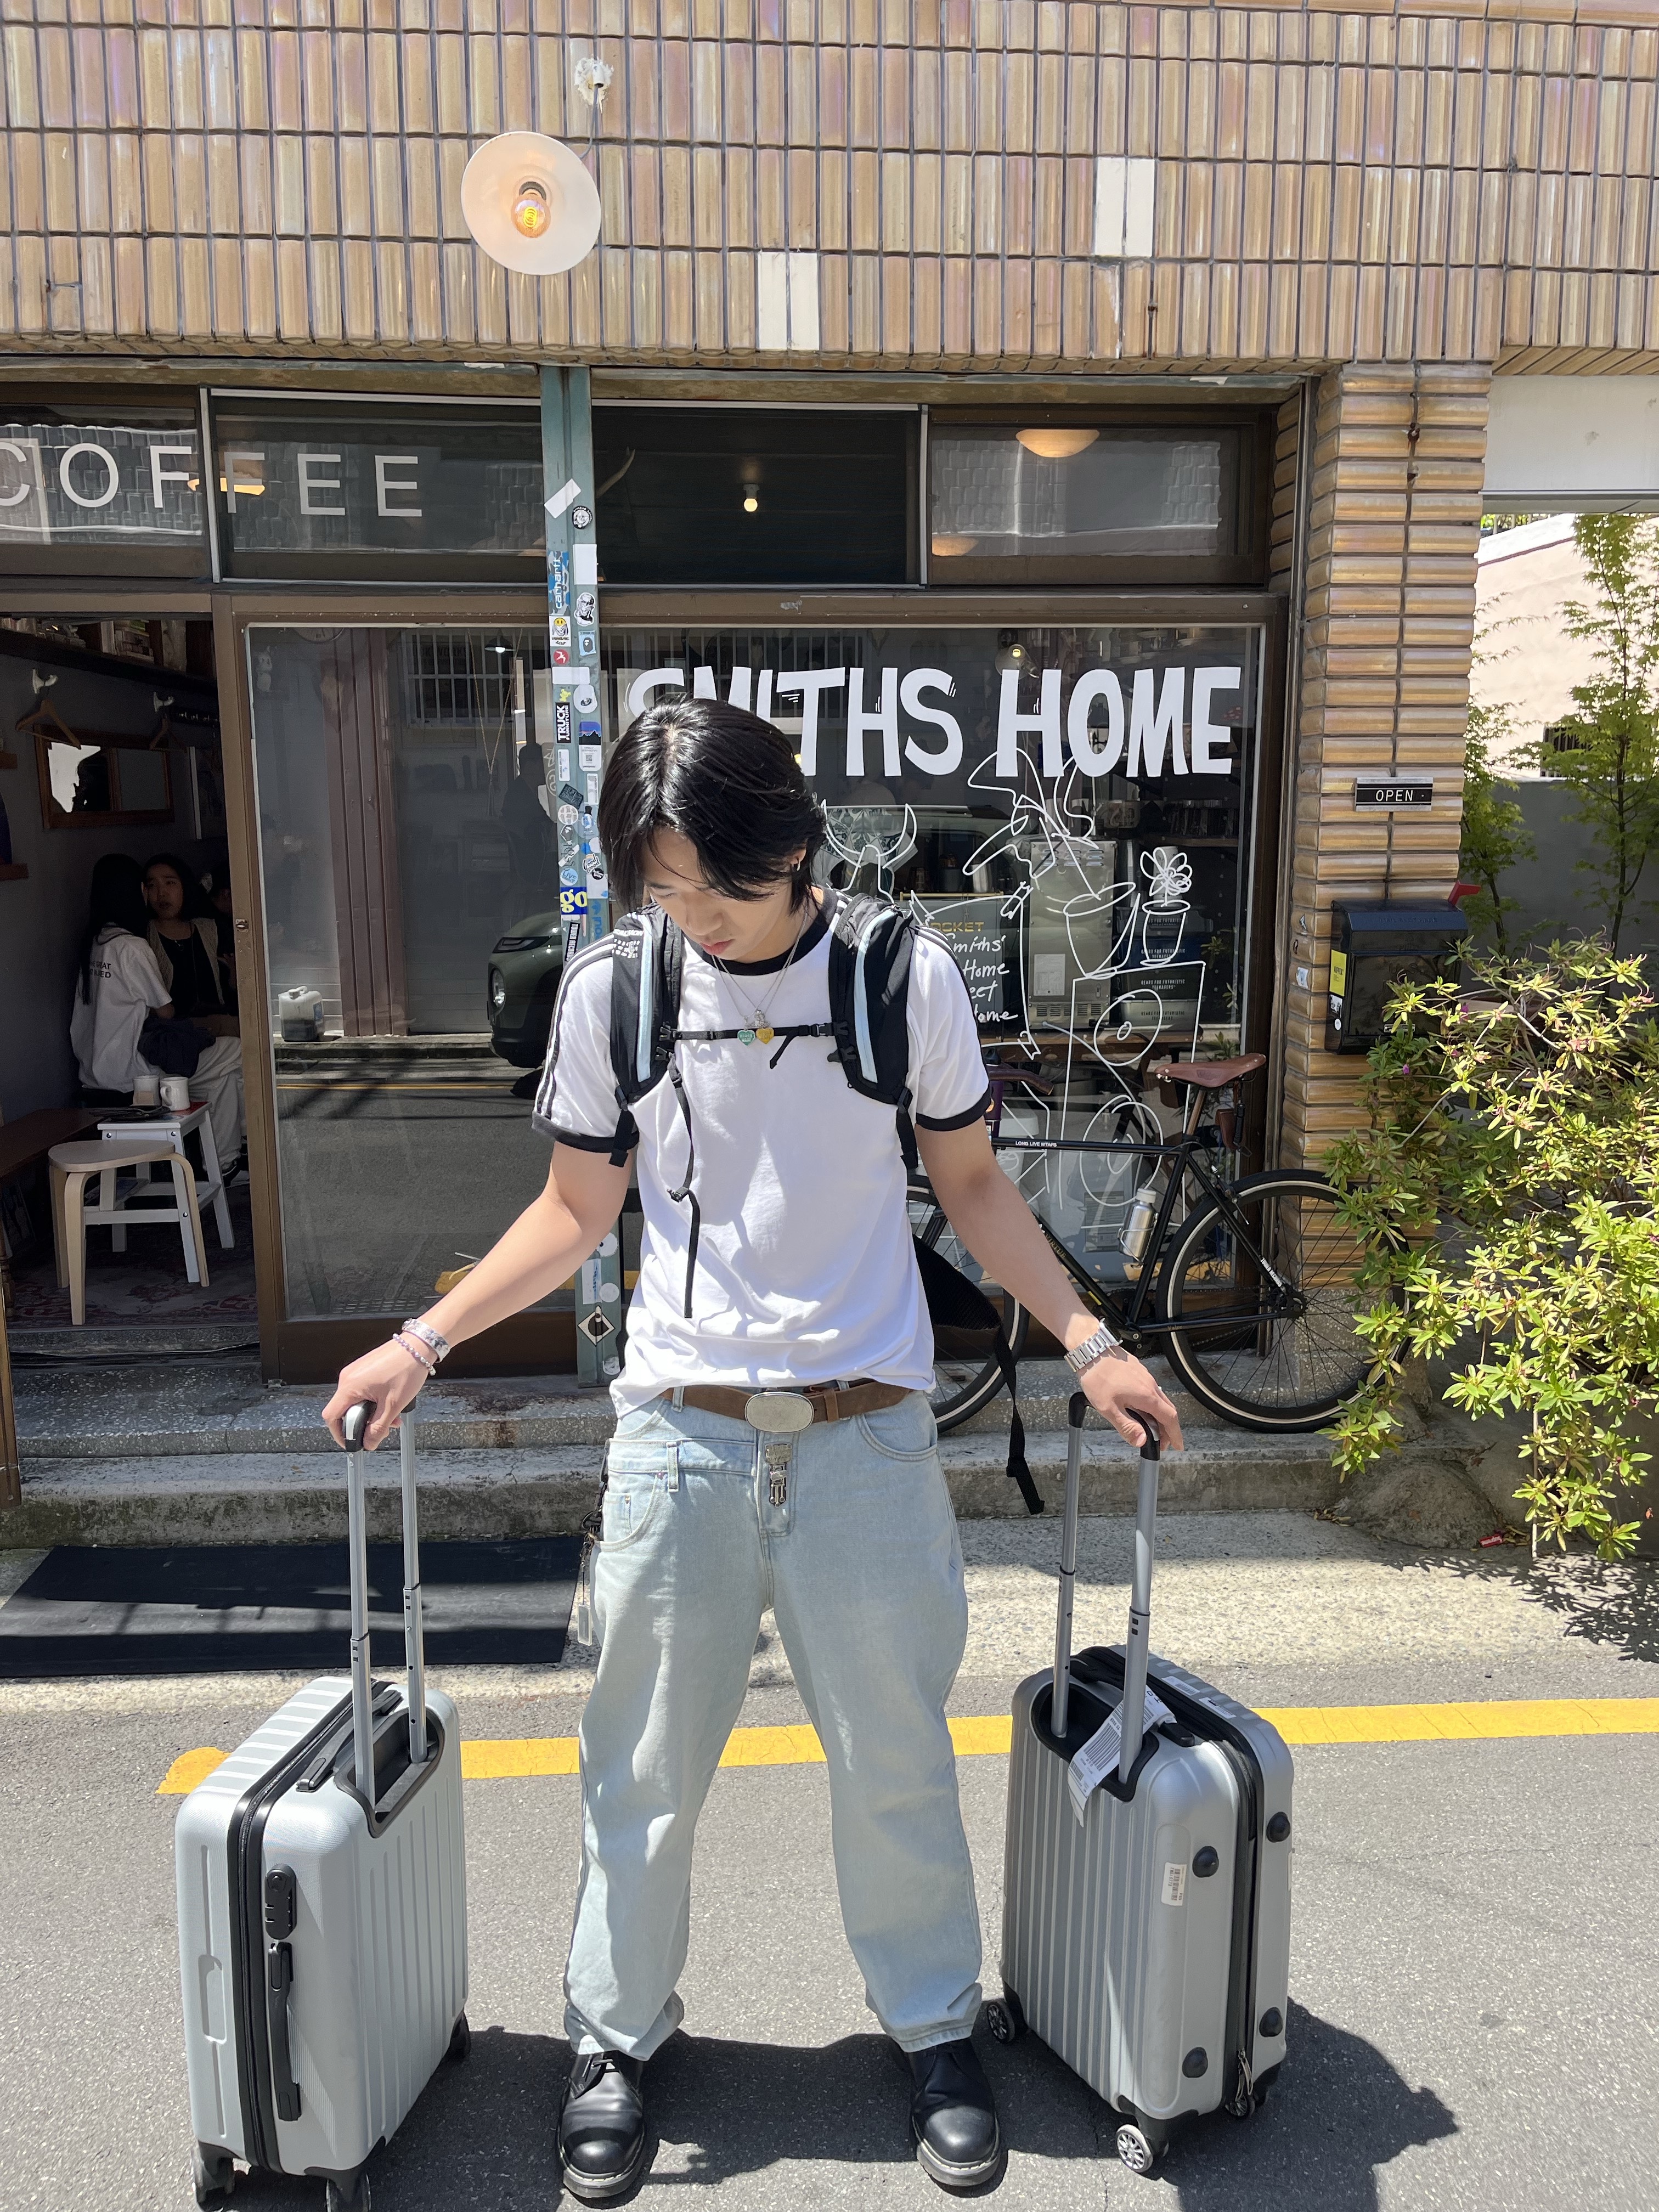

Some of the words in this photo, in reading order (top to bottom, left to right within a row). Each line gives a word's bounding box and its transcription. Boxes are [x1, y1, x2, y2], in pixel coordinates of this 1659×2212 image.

[553, 557, 562, 609] carhartt
[556, 705, 566, 741] TRUCK
[996, 666, 1241, 777] HOME
[1375, 789, 1414, 802] OPEN
[560, 889, 587, 913] go
[923, 922, 984, 933] OCKET
[962, 959, 1010, 980] Home
[1045, 1233, 1066, 1259] VIRTUE
